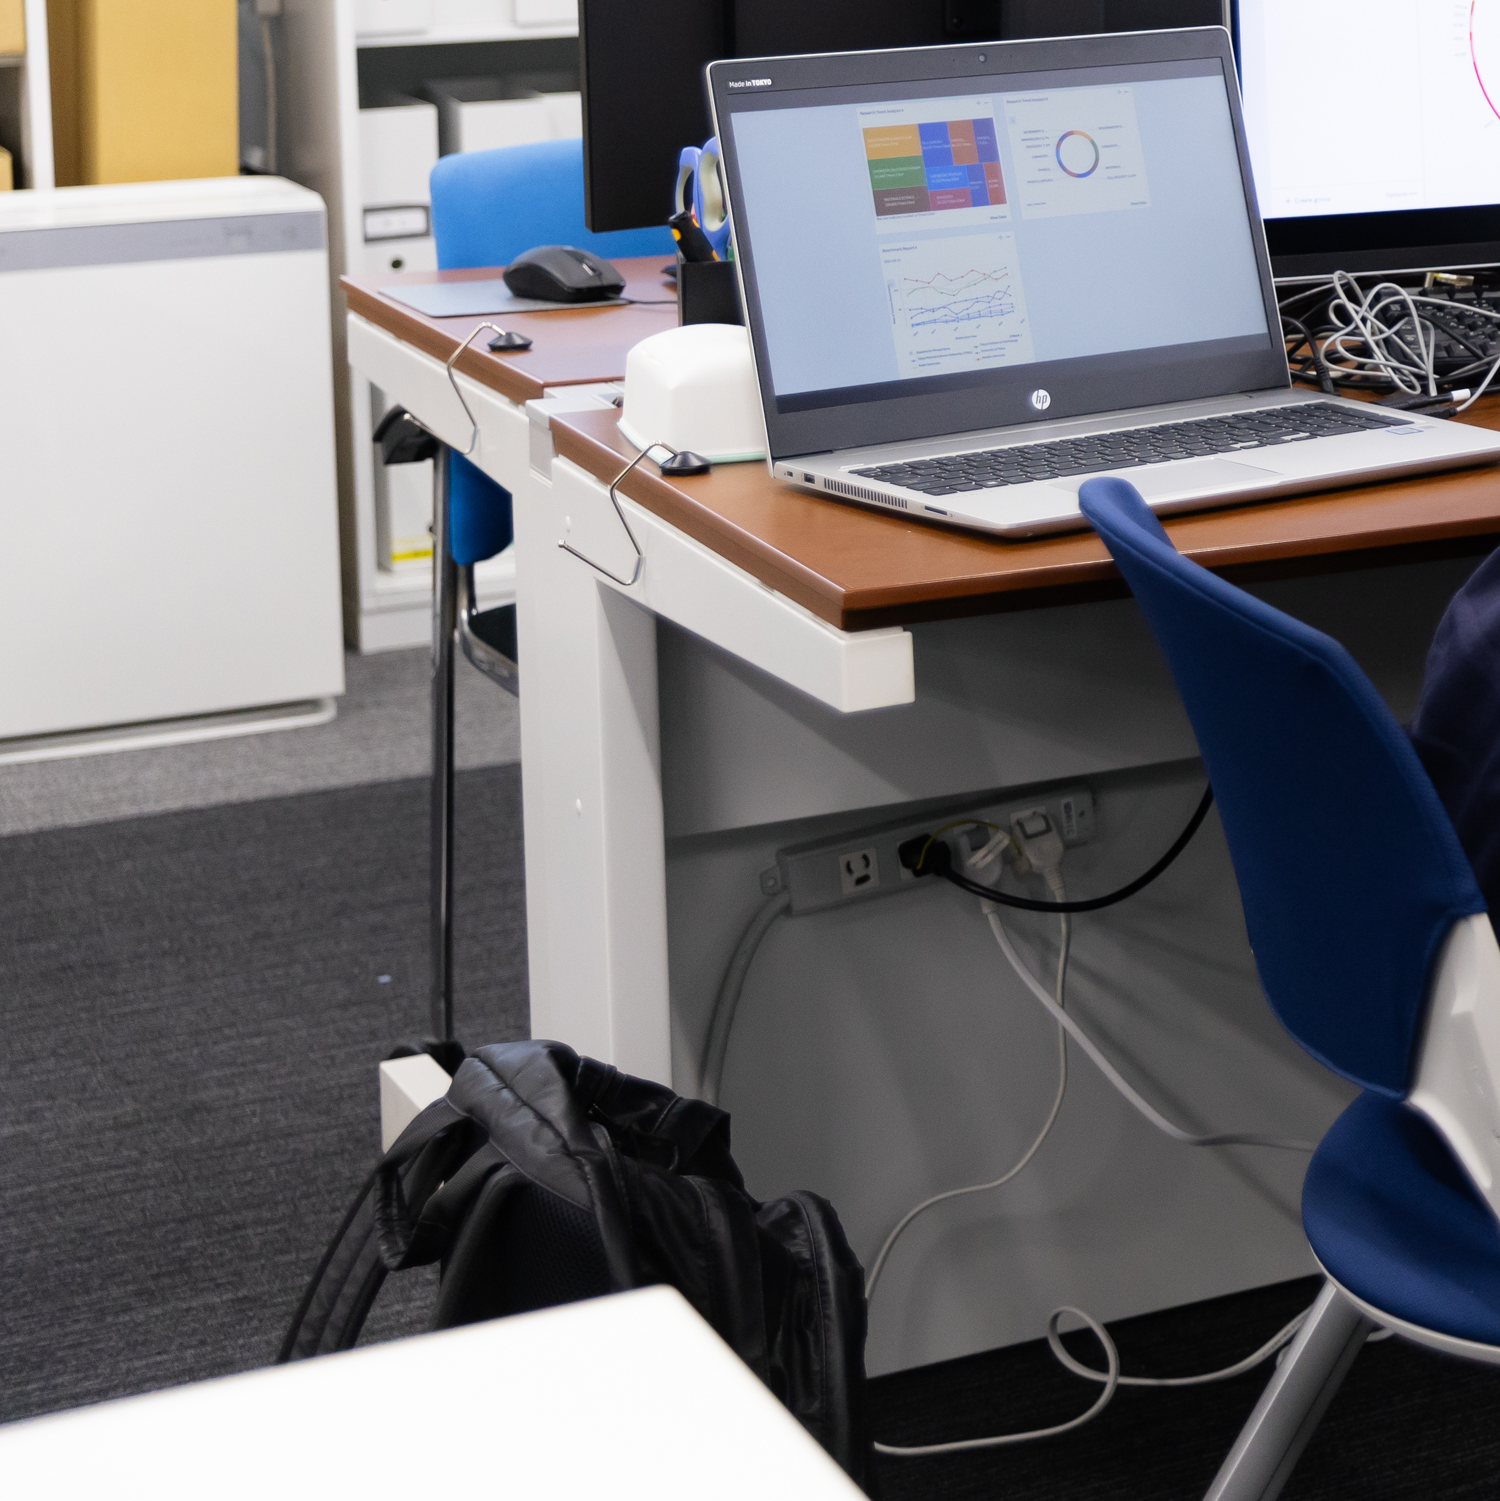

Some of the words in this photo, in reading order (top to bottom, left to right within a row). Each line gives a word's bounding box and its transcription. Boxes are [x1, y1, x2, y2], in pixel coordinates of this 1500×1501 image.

[729, 80, 745, 88] Made
[751, 78, 772, 87] TOKYO
[1034, 389, 1050, 410] hp
